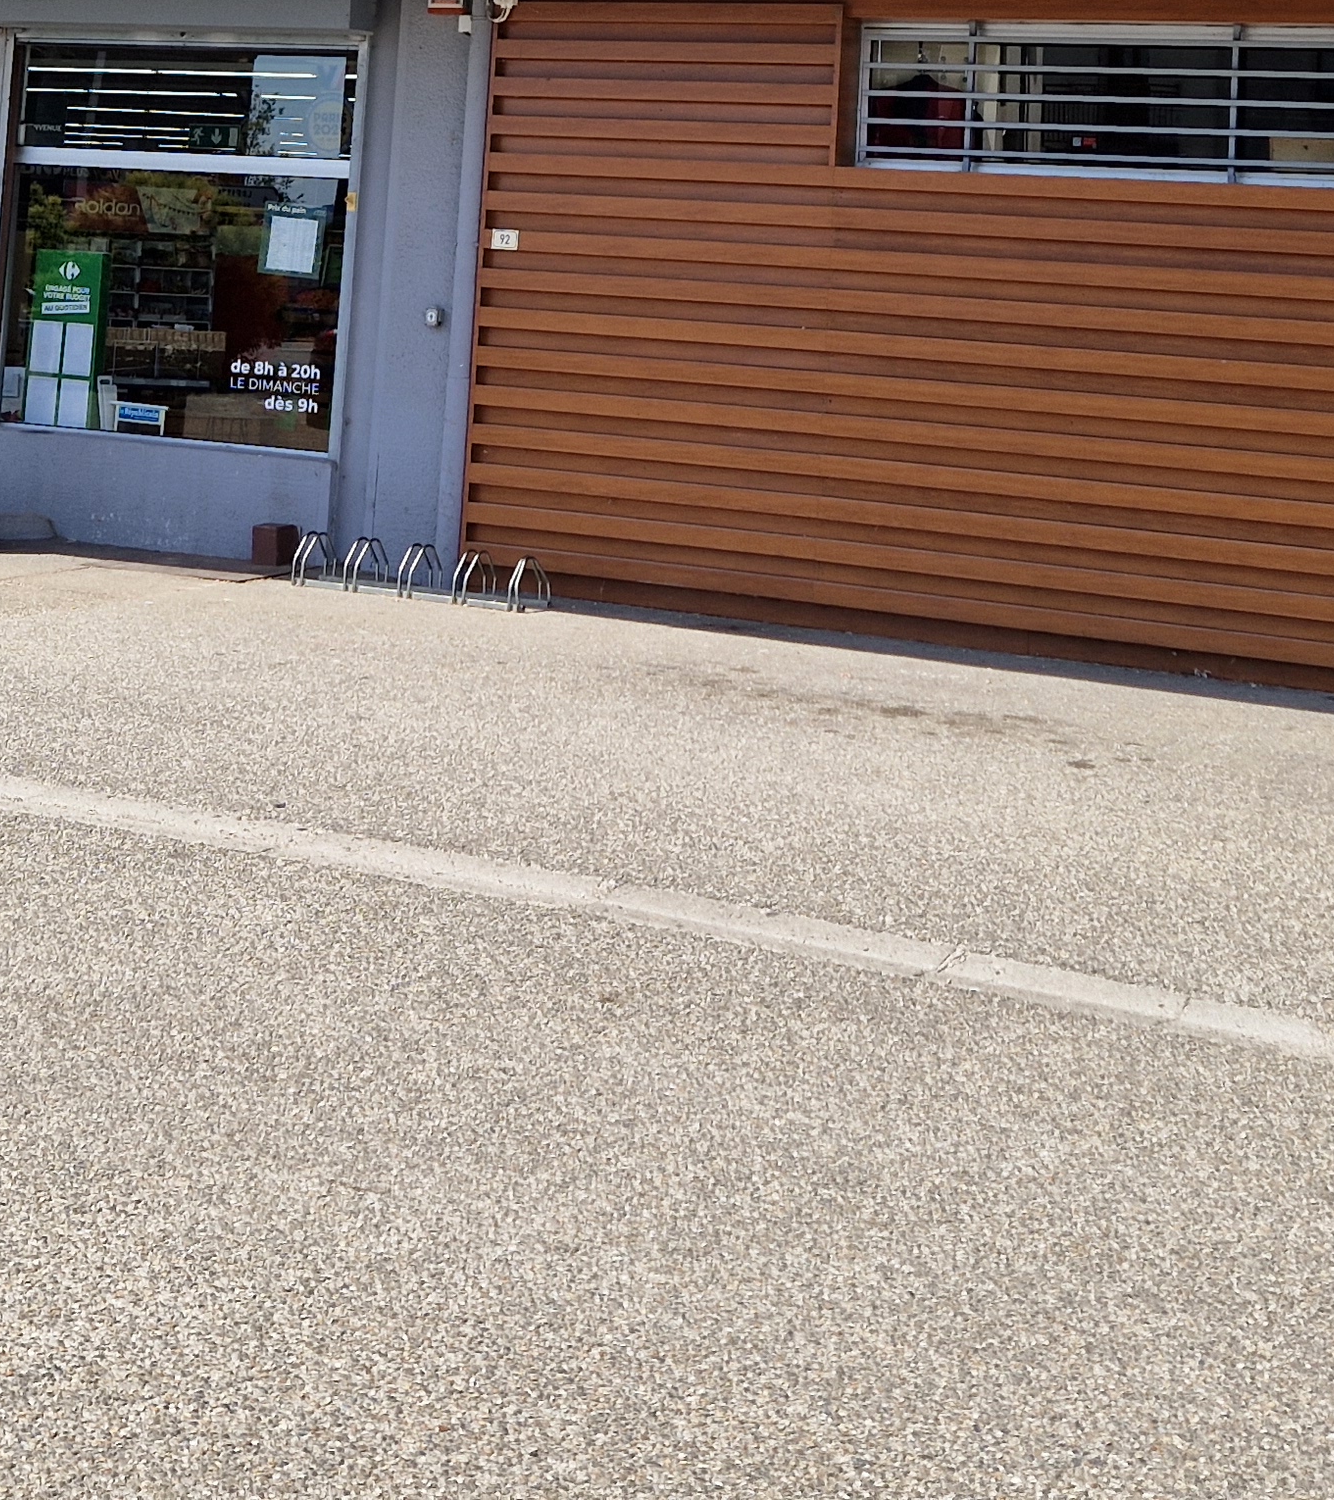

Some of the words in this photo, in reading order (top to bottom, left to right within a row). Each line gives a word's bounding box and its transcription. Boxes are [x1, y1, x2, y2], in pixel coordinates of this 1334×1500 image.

[499, 233, 511, 245] 92
[230, 359, 251, 374] de
[253, 360, 274, 376] 8h
[277, 362, 287, 378] à
[291, 364, 321, 380] 20h
[229, 376, 245, 389] LE
[248, 378, 320, 396] DIMANCHE
[264, 395, 293, 412] dès
[297, 398, 319, 414] 9h
